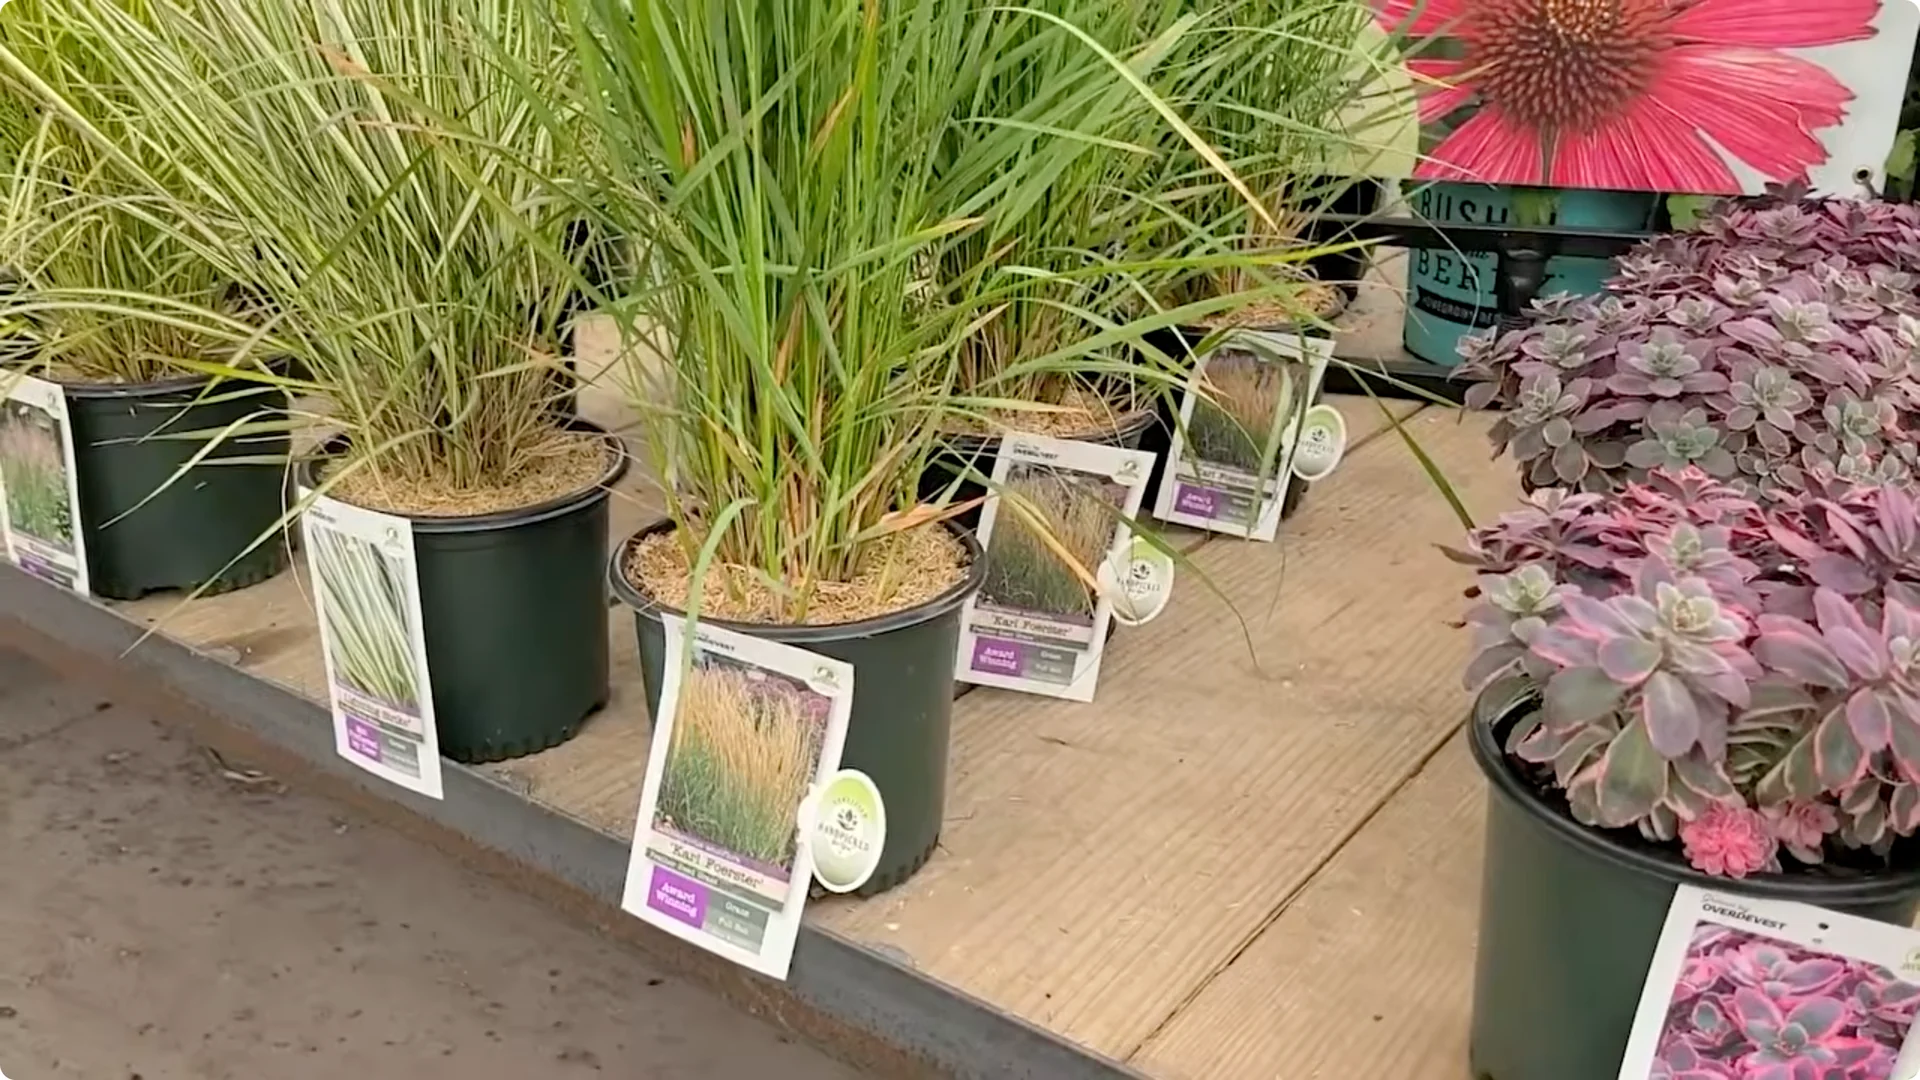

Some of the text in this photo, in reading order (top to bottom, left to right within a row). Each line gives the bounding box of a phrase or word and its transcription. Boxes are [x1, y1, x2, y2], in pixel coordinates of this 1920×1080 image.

[984, 646, 1015, 660] Award
[656, 889, 699, 918] Winning
[661, 881, 696, 904] Award
[1702, 903, 1787, 930] OVERDEVEST
